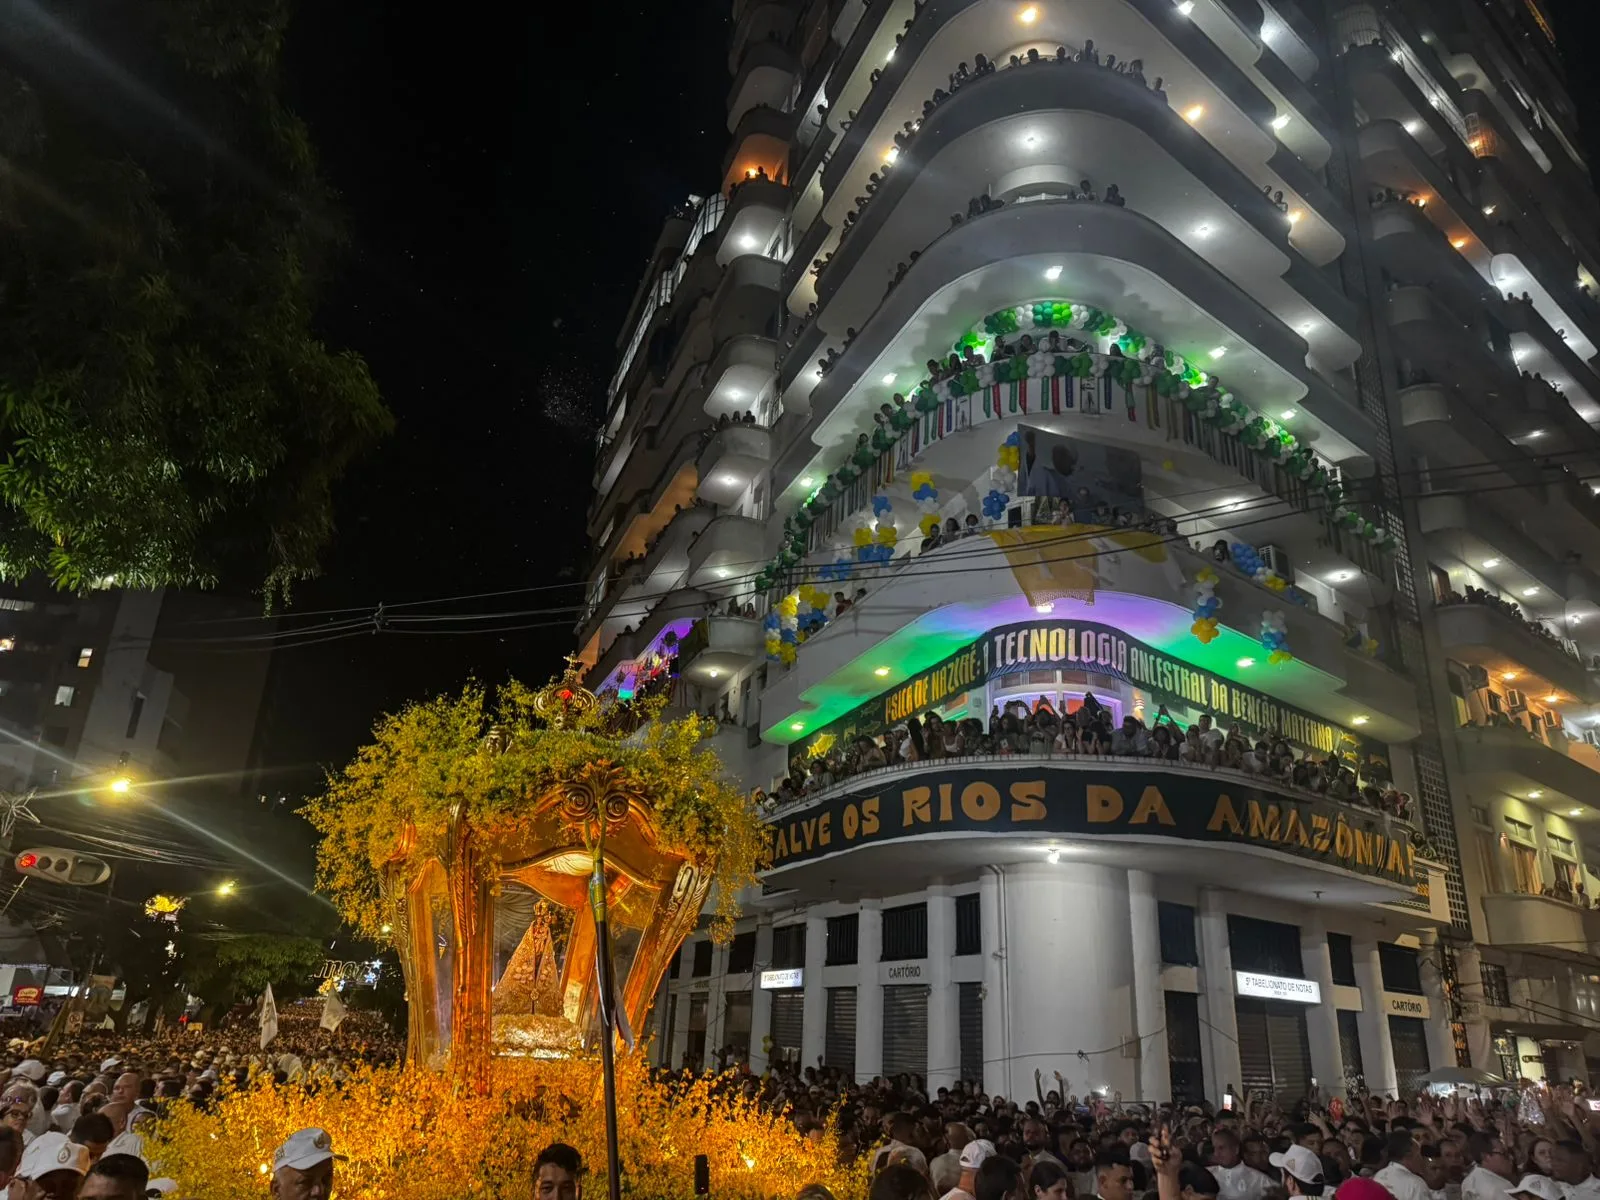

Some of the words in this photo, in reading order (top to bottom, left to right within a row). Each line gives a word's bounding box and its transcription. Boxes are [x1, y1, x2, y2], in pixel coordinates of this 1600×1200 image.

[914, 675, 929, 709] DE
[994, 628, 1127, 674] TECNOLOGIA
[1131, 647, 1209, 706] ANCESTRAL
[1211, 678, 1229, 714] DA
[1280, 707, 1333, 753] MATERNA
[842, 796, 880, 840] OS
[902, 780, 1048, 827] RIOS
[1086, 784, 1177, 827] DA
[888, 964, 921, 979] CARTÓRIO
[1288, 982, 1295, 991] DE
[1295, 984, 1313, 994] NOTAS
[1391, 998, 1422, 1014] CARTÓRIO
